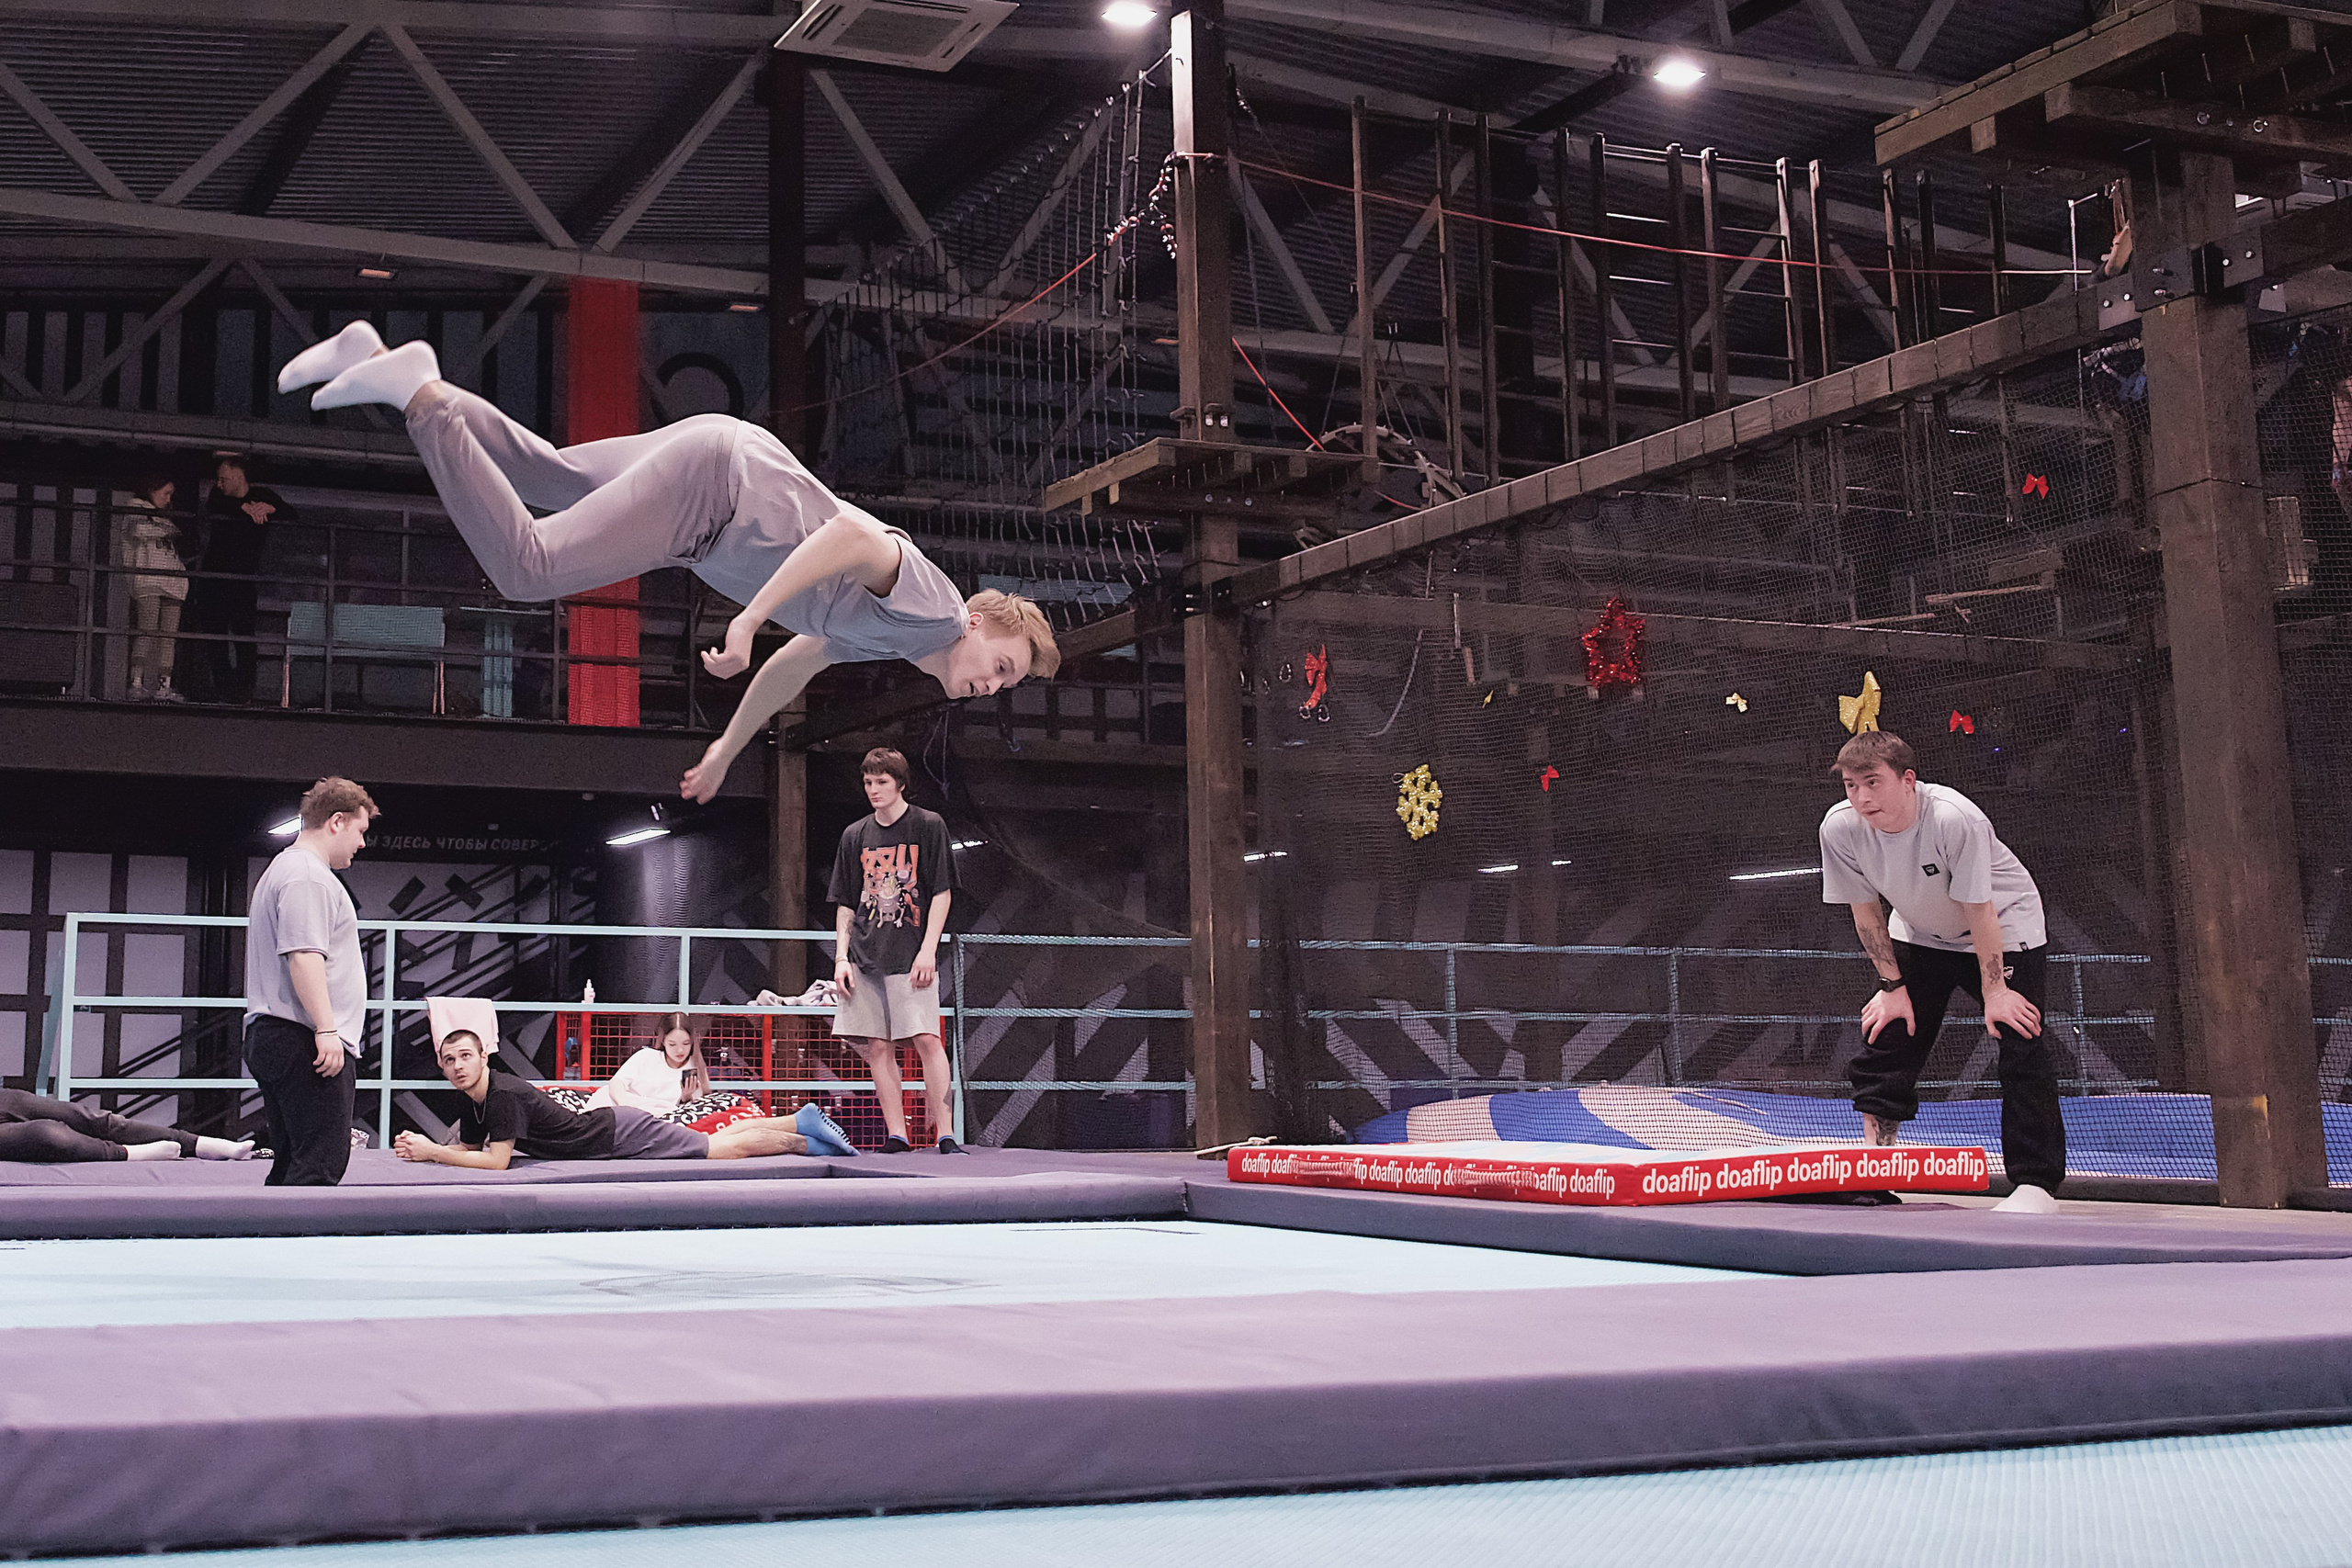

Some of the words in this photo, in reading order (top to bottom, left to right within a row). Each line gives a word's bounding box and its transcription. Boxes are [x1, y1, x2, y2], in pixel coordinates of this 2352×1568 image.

[381, 836, 432, 850] ЗДЕСЬ
[436, 837, 488, 851] ЧТОБЫ
[491, 838, 551, 852] СОВЕР
[1241, 1152, 1271, 1179] doaflip
[1369, 1158, 1403, 1188] doaflip
[1405, 1161, 1442, 1190] doaflip
[1531, 1167, 1567, 1198] oaflip
[1569, 1167, 1615, 1200] doaflip
[1642, 1166, 1712, 1197] doaflip
[1716, 1159, 1782, 1190] doaflip
[1787, 1154, 1852, 1185] doaflip
[1856, 1152, 1919, 1182] doaflip
[1924, 1151, 1984, 1182] doaflip
